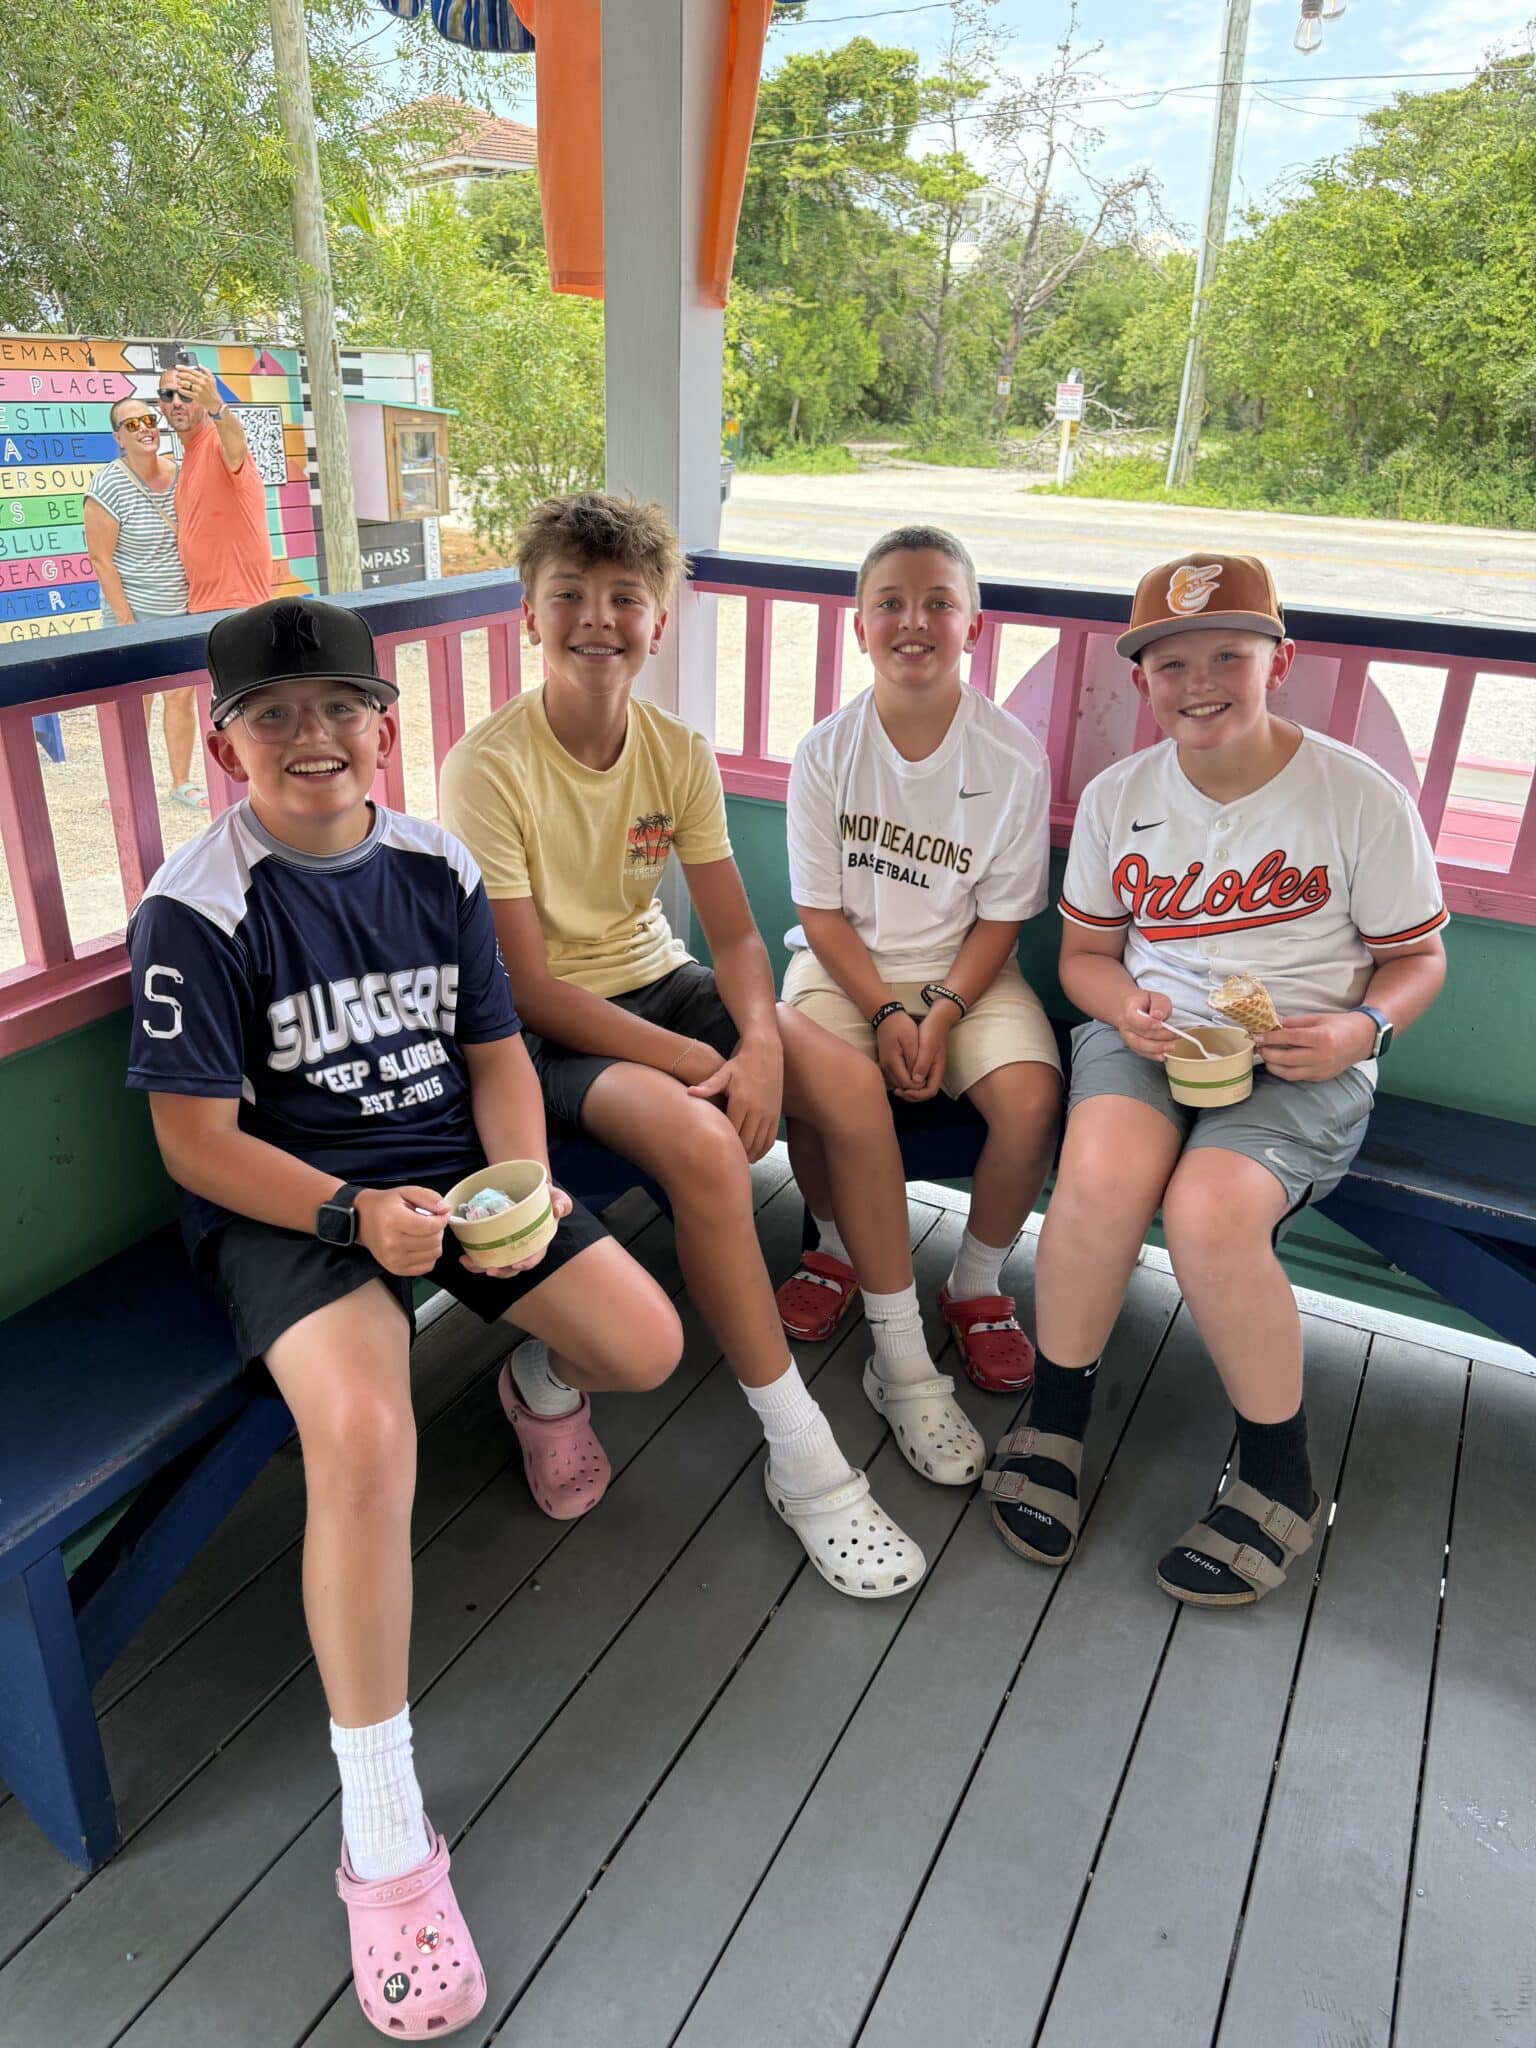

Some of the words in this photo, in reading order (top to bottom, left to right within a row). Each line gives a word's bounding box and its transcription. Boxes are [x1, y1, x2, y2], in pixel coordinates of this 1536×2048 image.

[2, 344, 92, 363] EMARY
[30, 375, 116, 395] PLACE
[4, 437, 86, 462] ASIDE
[47, 500, 79, 520] BE
[0, 531, 62, 557] BLUE
[10, 616, 95, 642] GRAYT
[881, 821, 973, 875] DEACONS
[1112, 849, 1332, 921] Orioles
[142, 964, 184, 1039] S
[267, 964, 459, 1072] SLUGGERS
[359, 1076, 445, 1117] EST.2015
[1183, 1551, 1221, 1575] DRI-FIT
